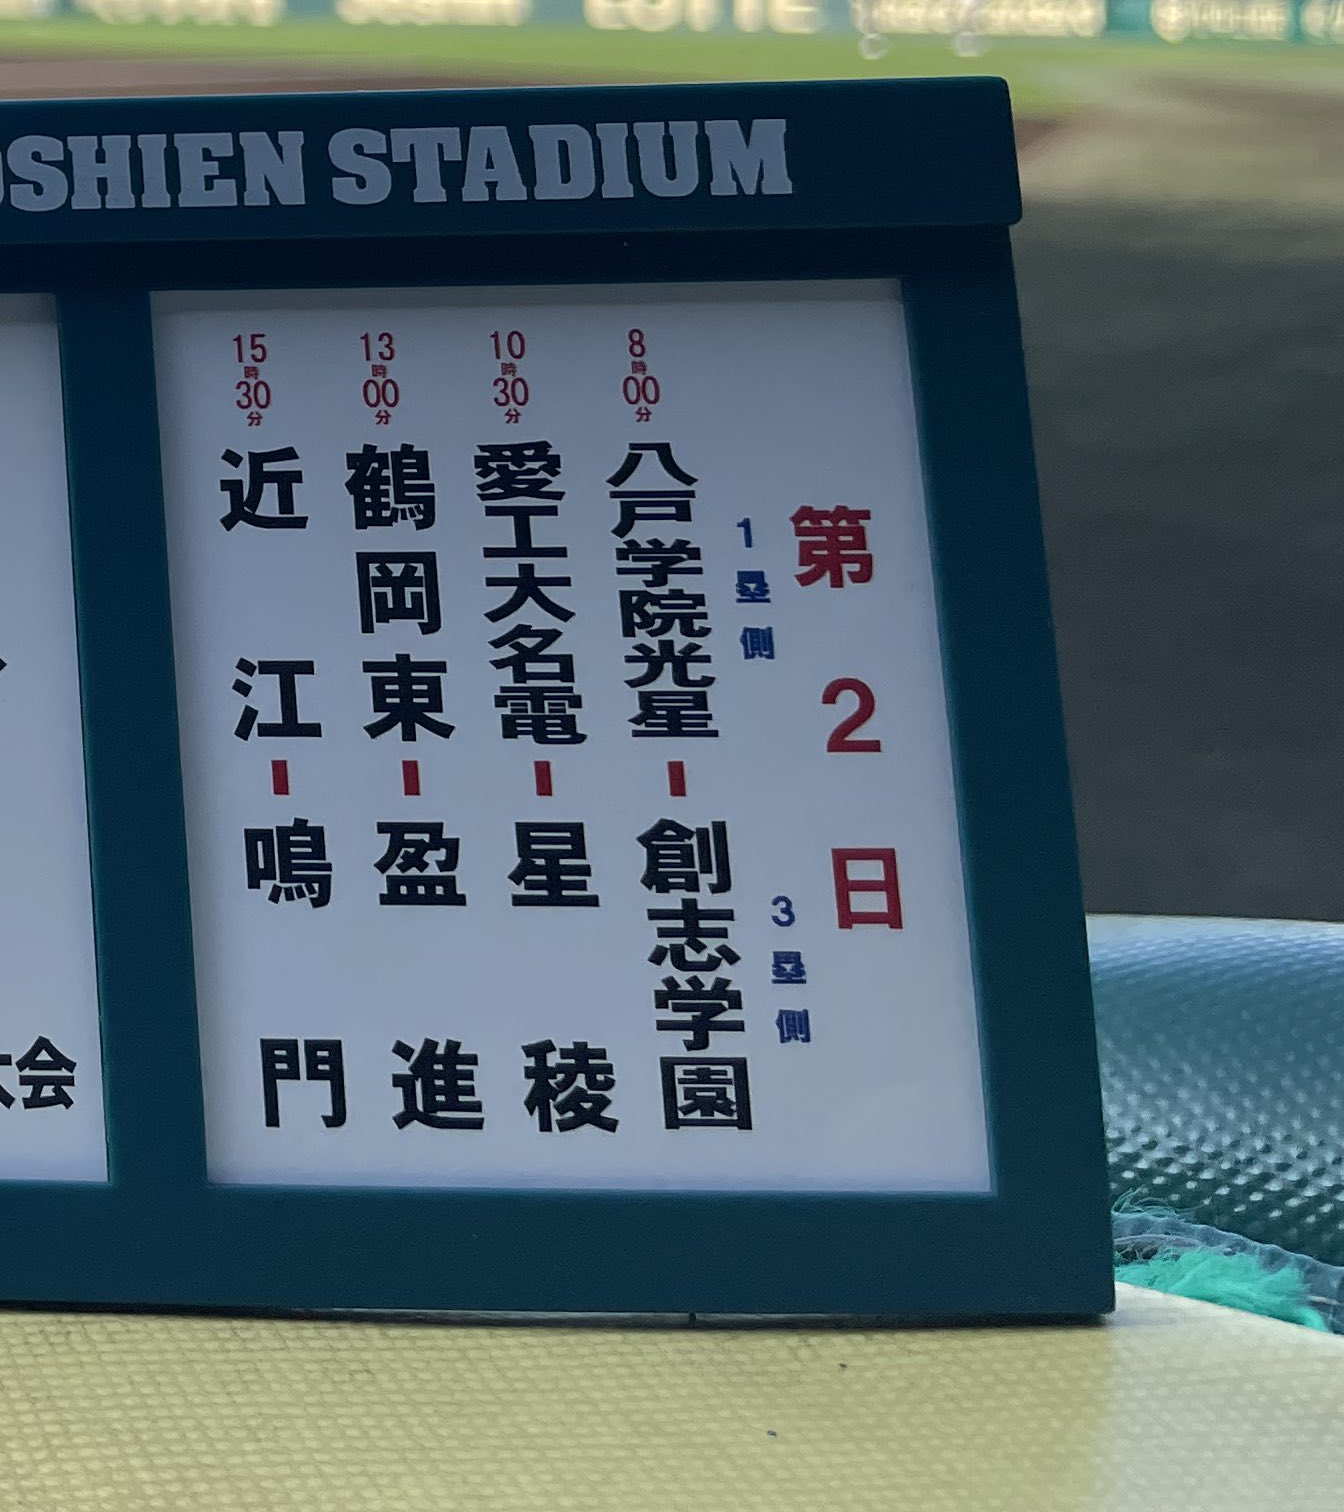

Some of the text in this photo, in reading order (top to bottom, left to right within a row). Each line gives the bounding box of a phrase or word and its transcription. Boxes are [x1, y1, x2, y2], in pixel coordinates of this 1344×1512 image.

[328, 118, 794, 205] STADIUM
[345, 442, 456, 743] 鶴岡東
[473, 439, 588, 745] 愛工大名電
[606, 441, 720, 739] 八戸学院光星
[635, 817, 753, 1132] 創志学園
